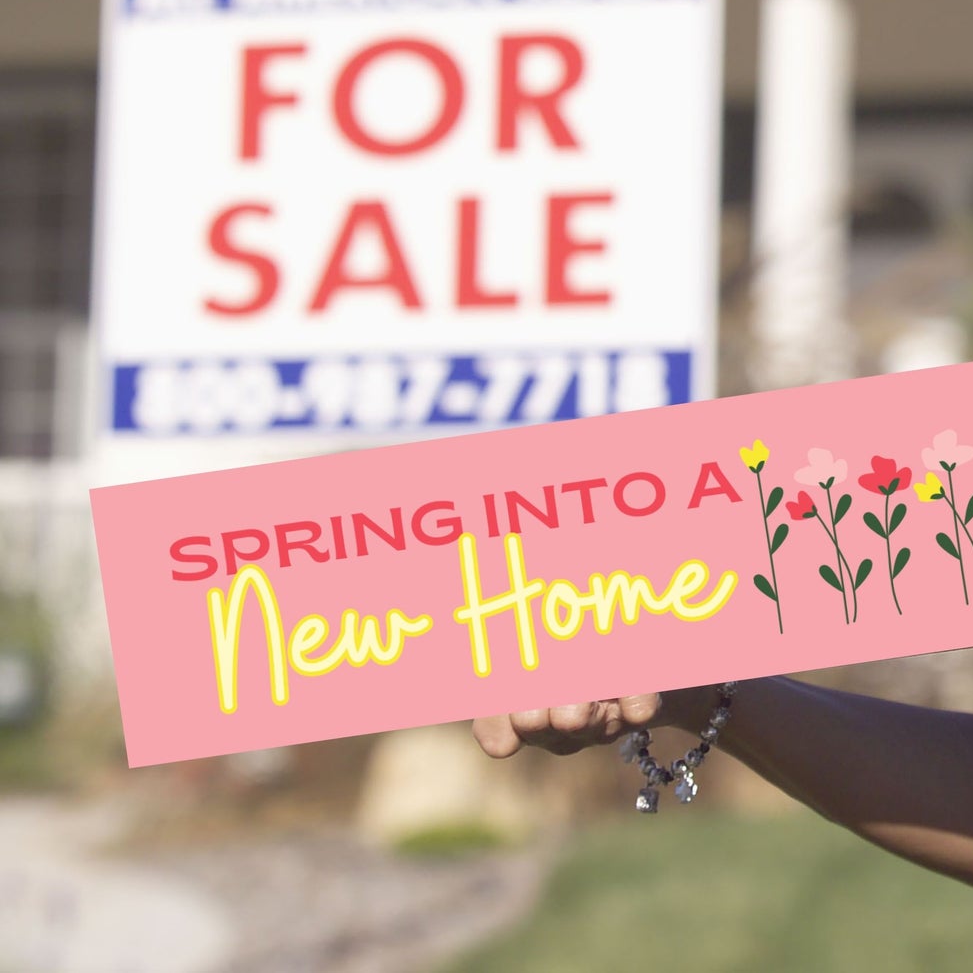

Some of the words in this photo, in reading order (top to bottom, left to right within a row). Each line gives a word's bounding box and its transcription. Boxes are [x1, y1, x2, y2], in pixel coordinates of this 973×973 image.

[236, 30, 588, 164] FOR
[202, 189, 617, 319] SALE
[170, 501, 463, 581] SPRING
[483, 472, 665, 537] INTO
[688, 462, 742, 508] A
[207, 564, 433, 714] New
[453, 533, 738, 677] Home
